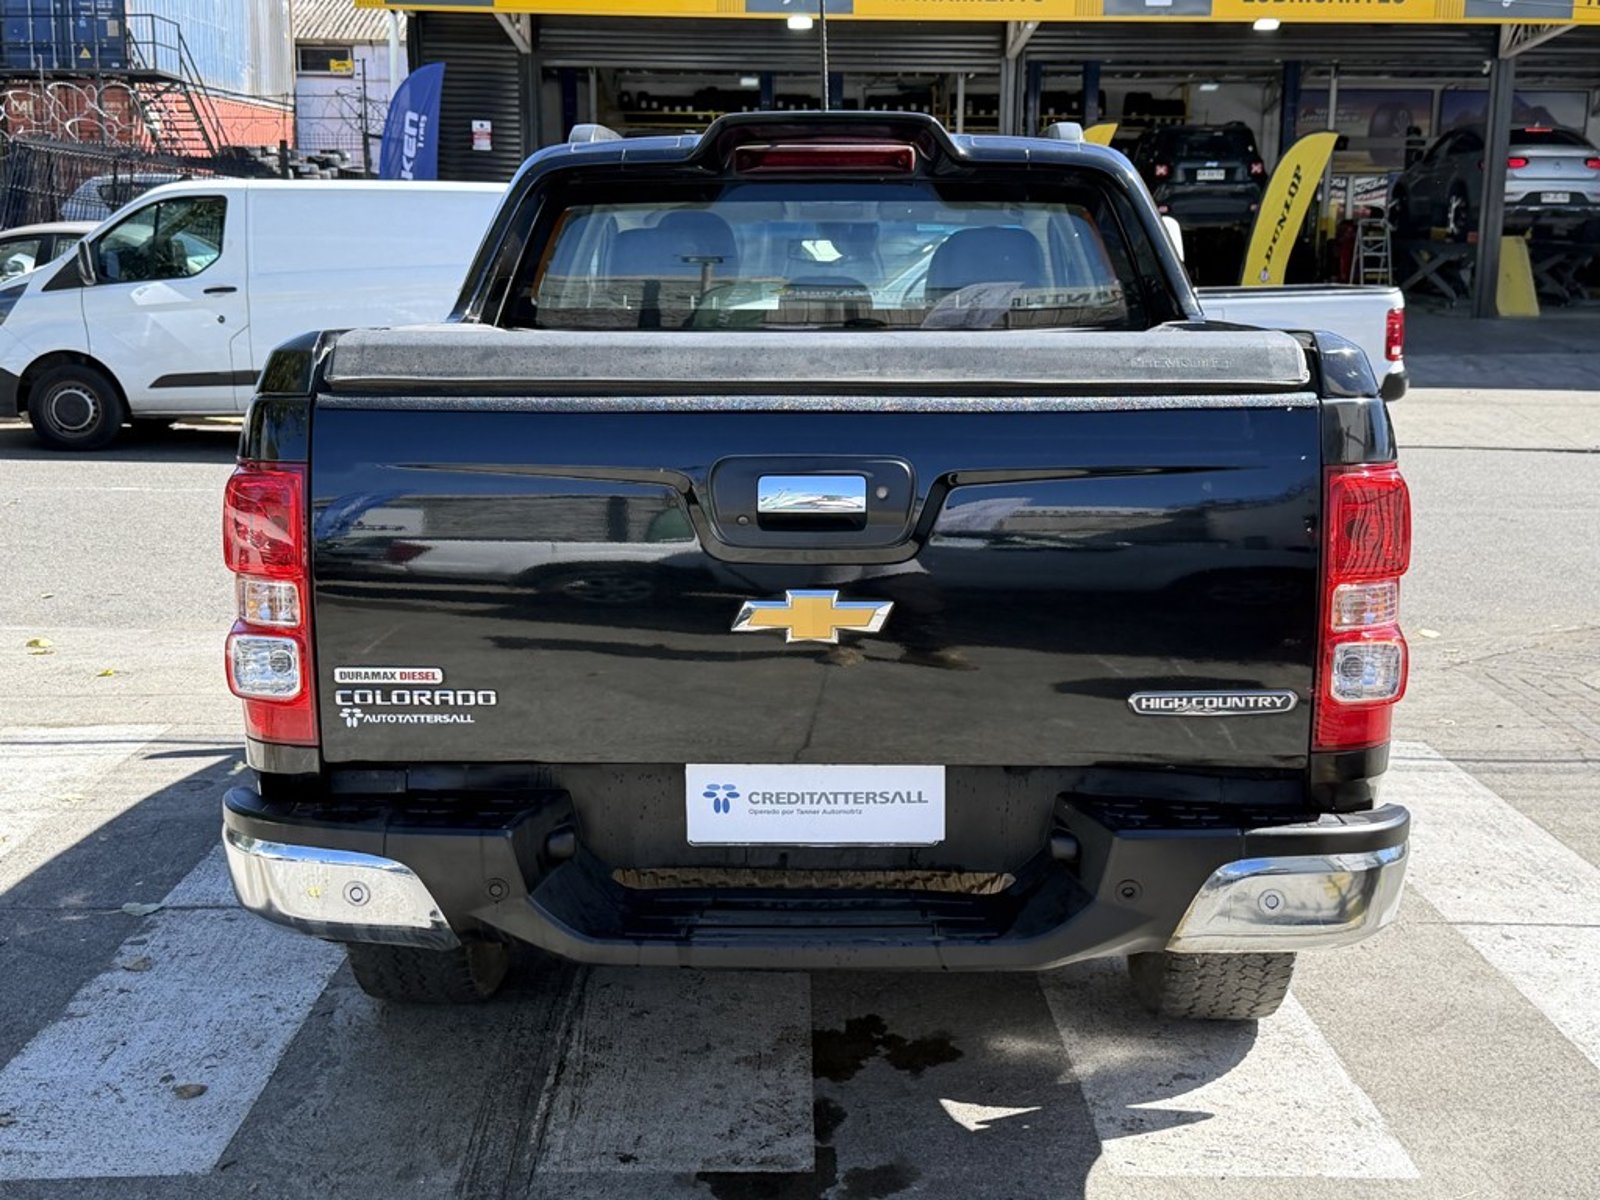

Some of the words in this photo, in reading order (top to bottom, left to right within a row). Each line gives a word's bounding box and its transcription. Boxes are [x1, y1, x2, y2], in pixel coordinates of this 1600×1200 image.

[1264, 163, 1302, 264] DUNLOP
[339, 671, 397, 681] DURAMAX
[399, 671, 438, 681] DIESEL
[335, 690, 497, 706] COLORADO
[1141, 697, 1186, 709] HIGH
[1191, 696, 1287, 709] COUNTRY
[363, 713, 475, 724] AUTOTATTERSALL
[747, 790, 929, 806] CREDITATTERSALL
